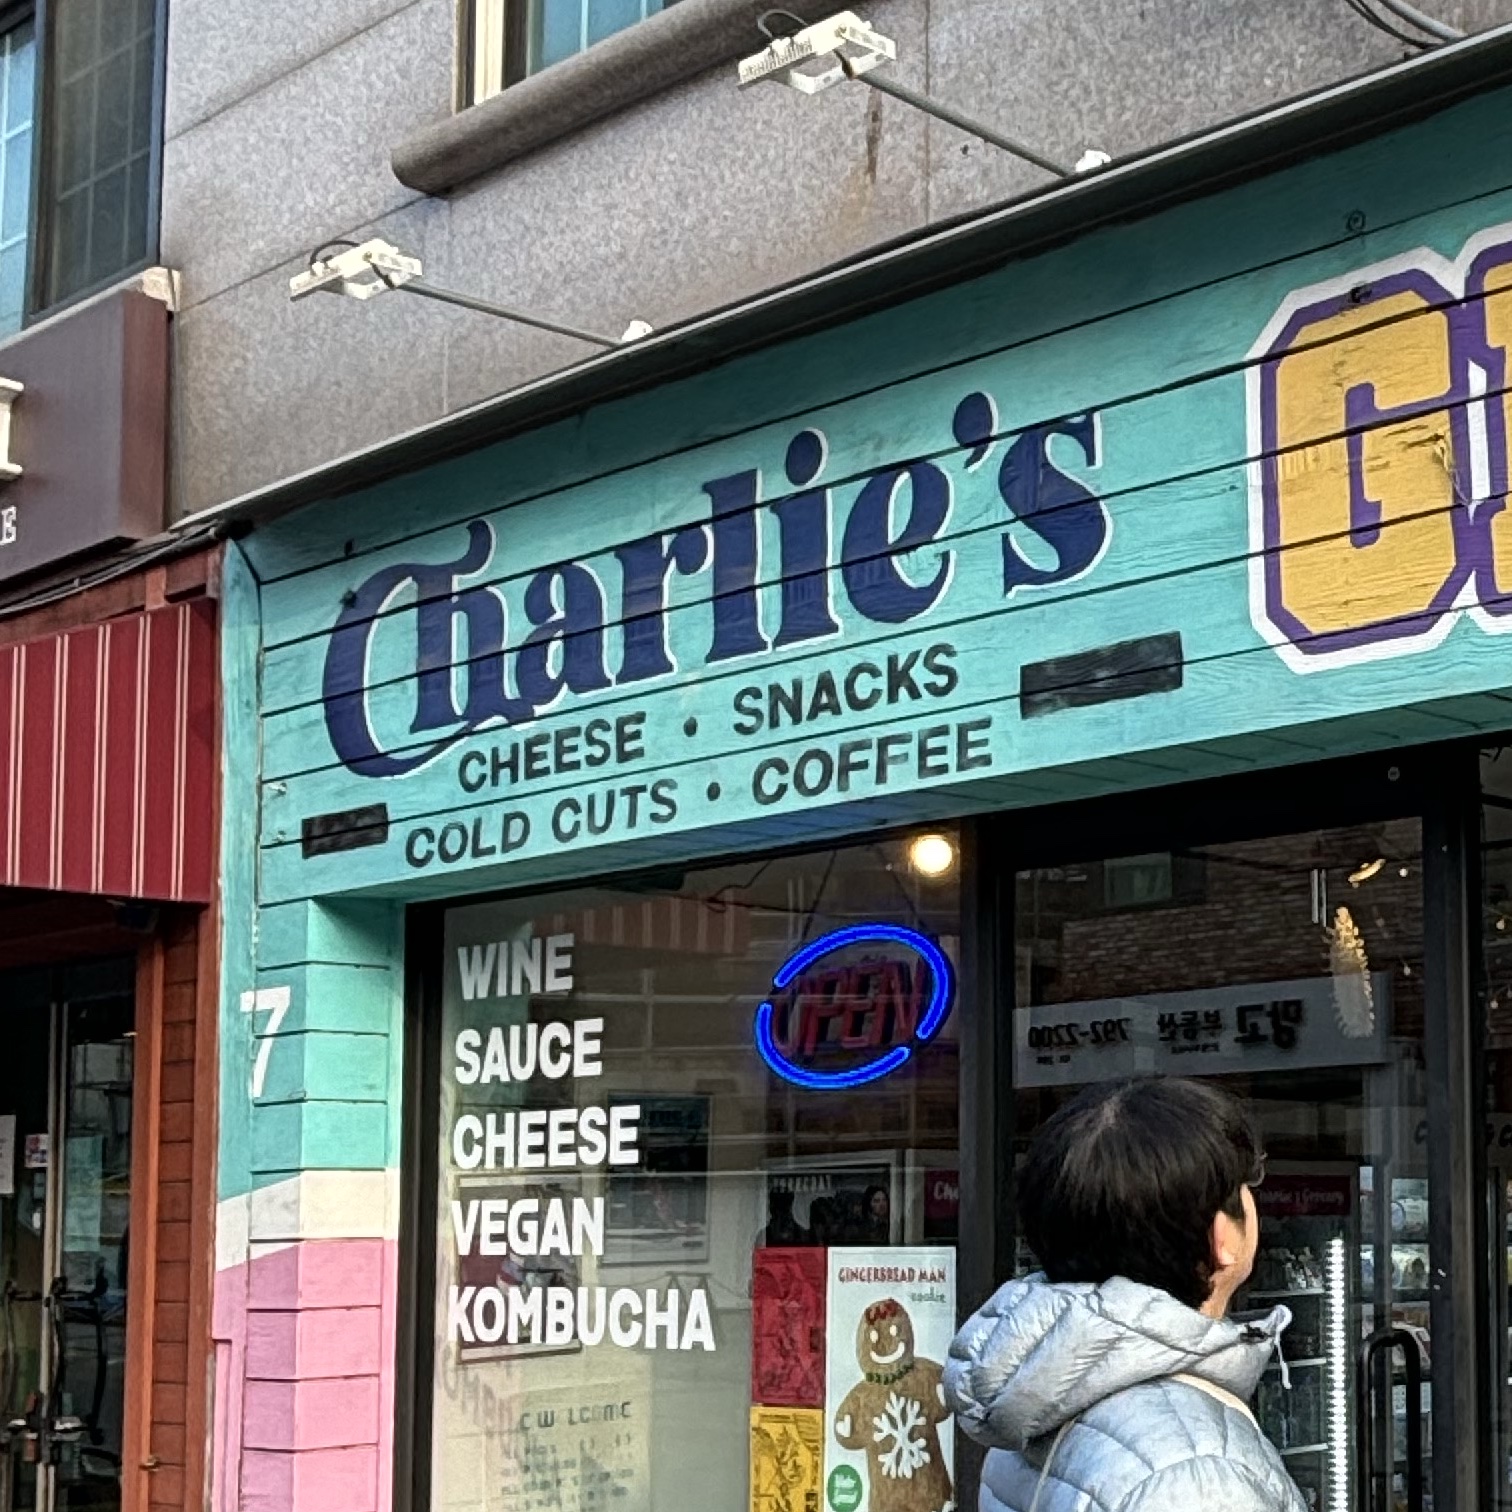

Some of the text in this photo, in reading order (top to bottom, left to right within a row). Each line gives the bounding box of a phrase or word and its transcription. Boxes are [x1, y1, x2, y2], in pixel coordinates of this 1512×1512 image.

[322, 391, 1113, 780] Charlie's
[733, 643, 960, 737] SNACKS
[457, 711, 647, 794] CHEESE
[750, 717, 994, 806] COFFEE
[404, 777, 680, 870] COLD CUTS
[458, 933, 575, 1000] WINE
[773, 956, 929, 1059] OPEN
[239, 986, 292, 1097] 7
[455, 1017, 605, 1086] SAUCE
[452, 1103, 642, 1170] CHEESE
[451, 1197, 606, 1256] VEGAN
[838, 1265, 947, 1284] GINGERBREAD MAN
[448, 1285, 717, 1351] KOMBUCHA
